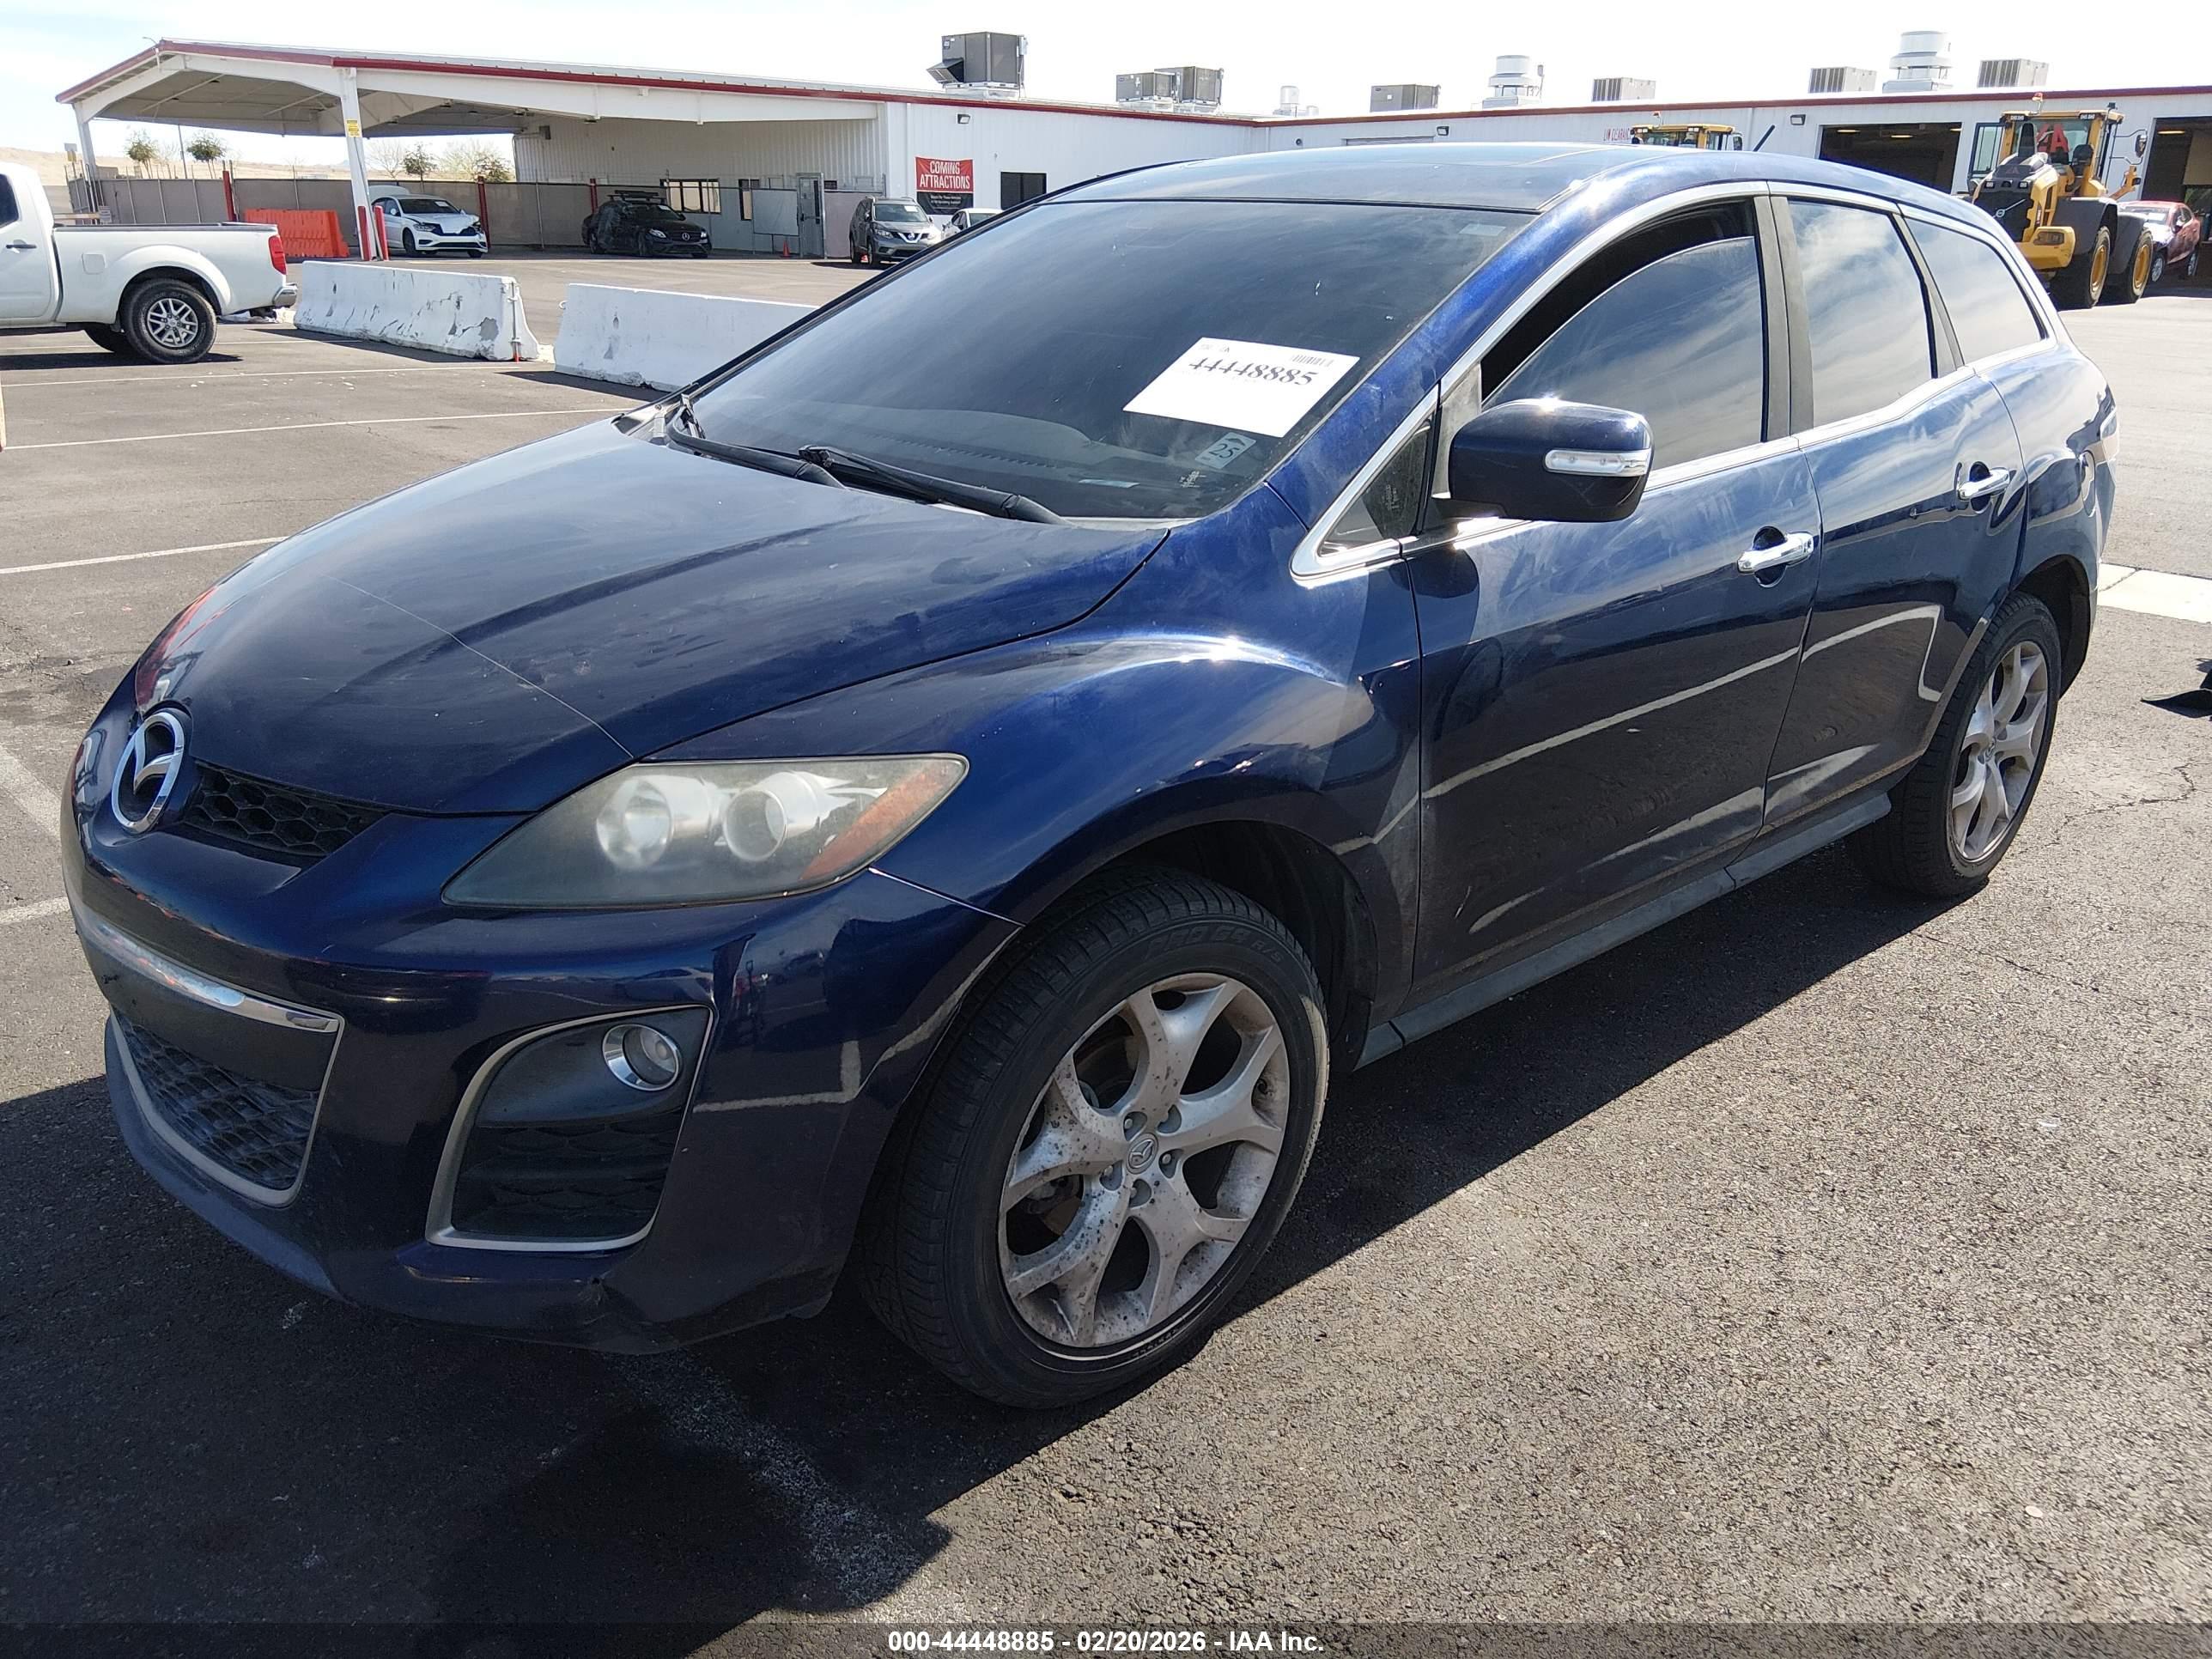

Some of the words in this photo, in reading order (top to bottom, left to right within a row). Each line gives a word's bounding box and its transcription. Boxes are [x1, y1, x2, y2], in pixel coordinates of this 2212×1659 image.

[930, 161, 960, 175] COMING
[920, 174, 970, 189] ATTRACTIONS
[1188, 357, 1318, 386] 44448885
[1208, 443, 1240, 459] 25
